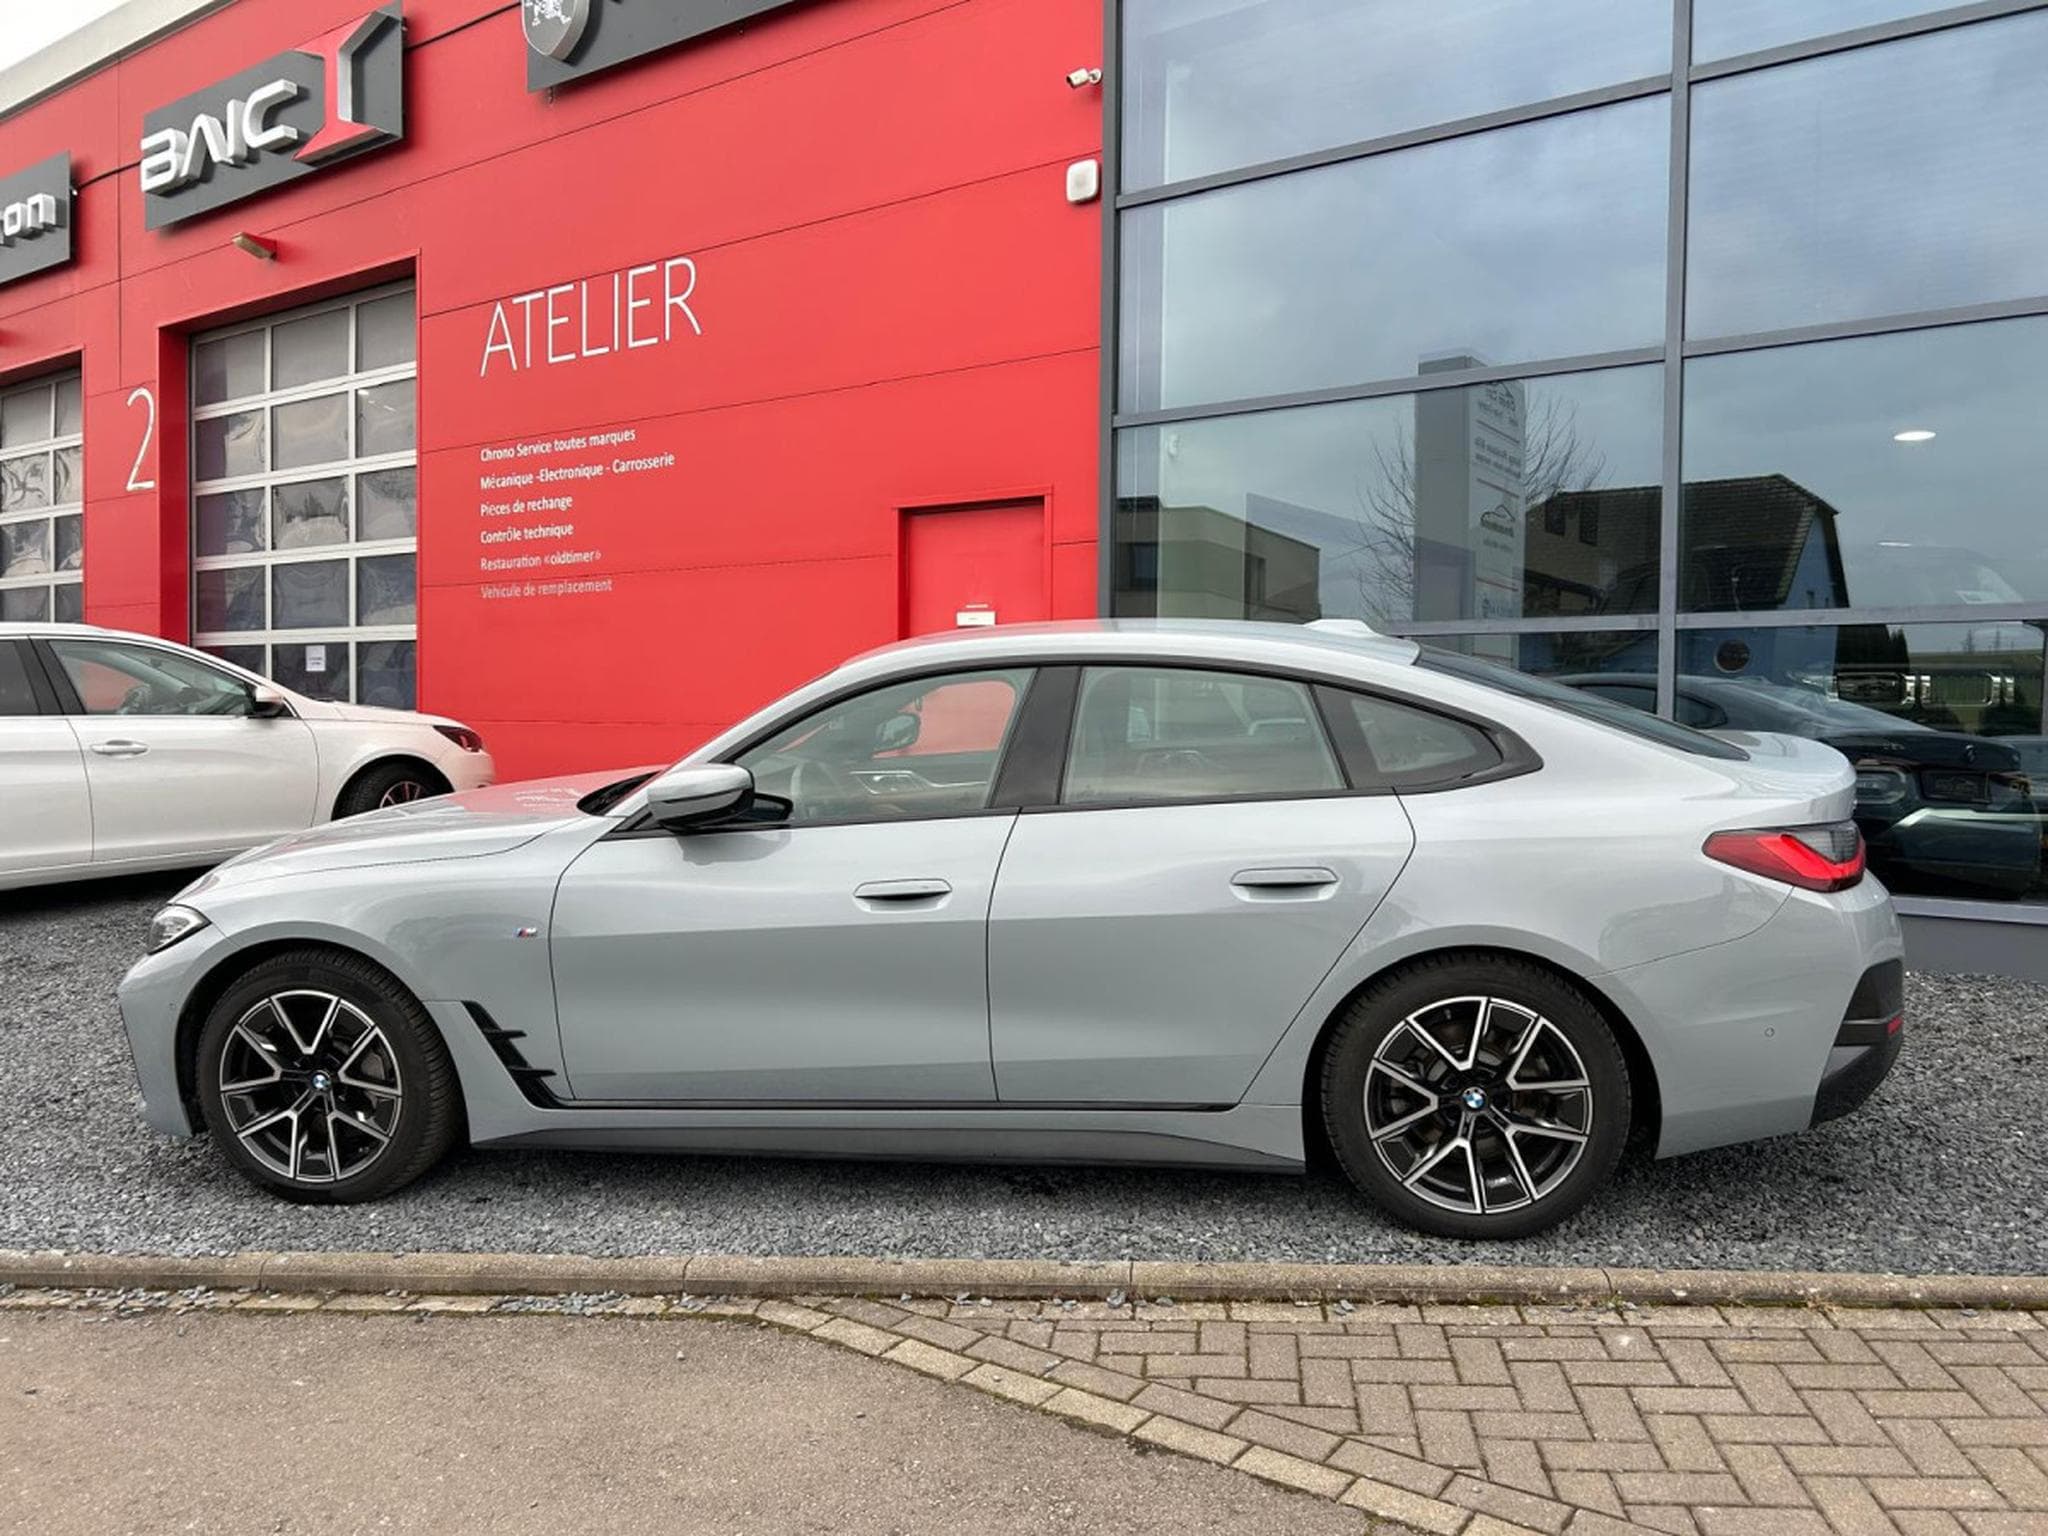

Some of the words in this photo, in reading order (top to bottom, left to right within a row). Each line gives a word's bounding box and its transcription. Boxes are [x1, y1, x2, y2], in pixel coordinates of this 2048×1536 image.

[140, 78, 298, 193] BAIC
[480, 256, 702, 378] ATELIER
[126, 387, 155, 492] 2
[480, 447, 516, 462] Chrono
[516, 441, 552, 456] Service
[553, 437, 587, 451] toutes
[589, 429, 636, 447] marques
[480, 473, 533, 490] Mécanique
[612, 452, 675, 474] Carrosserie
[512, 498, 526, 513] de
[527, 496, 573, 511] rechange
[480, 525, 522, 544] Contrôle
[523, 523, 574, 540] technique
[480, 556, 542, 571] Restauration
[524, 582, 537, 597] de
[538, 578, 613, 597] remplacement
